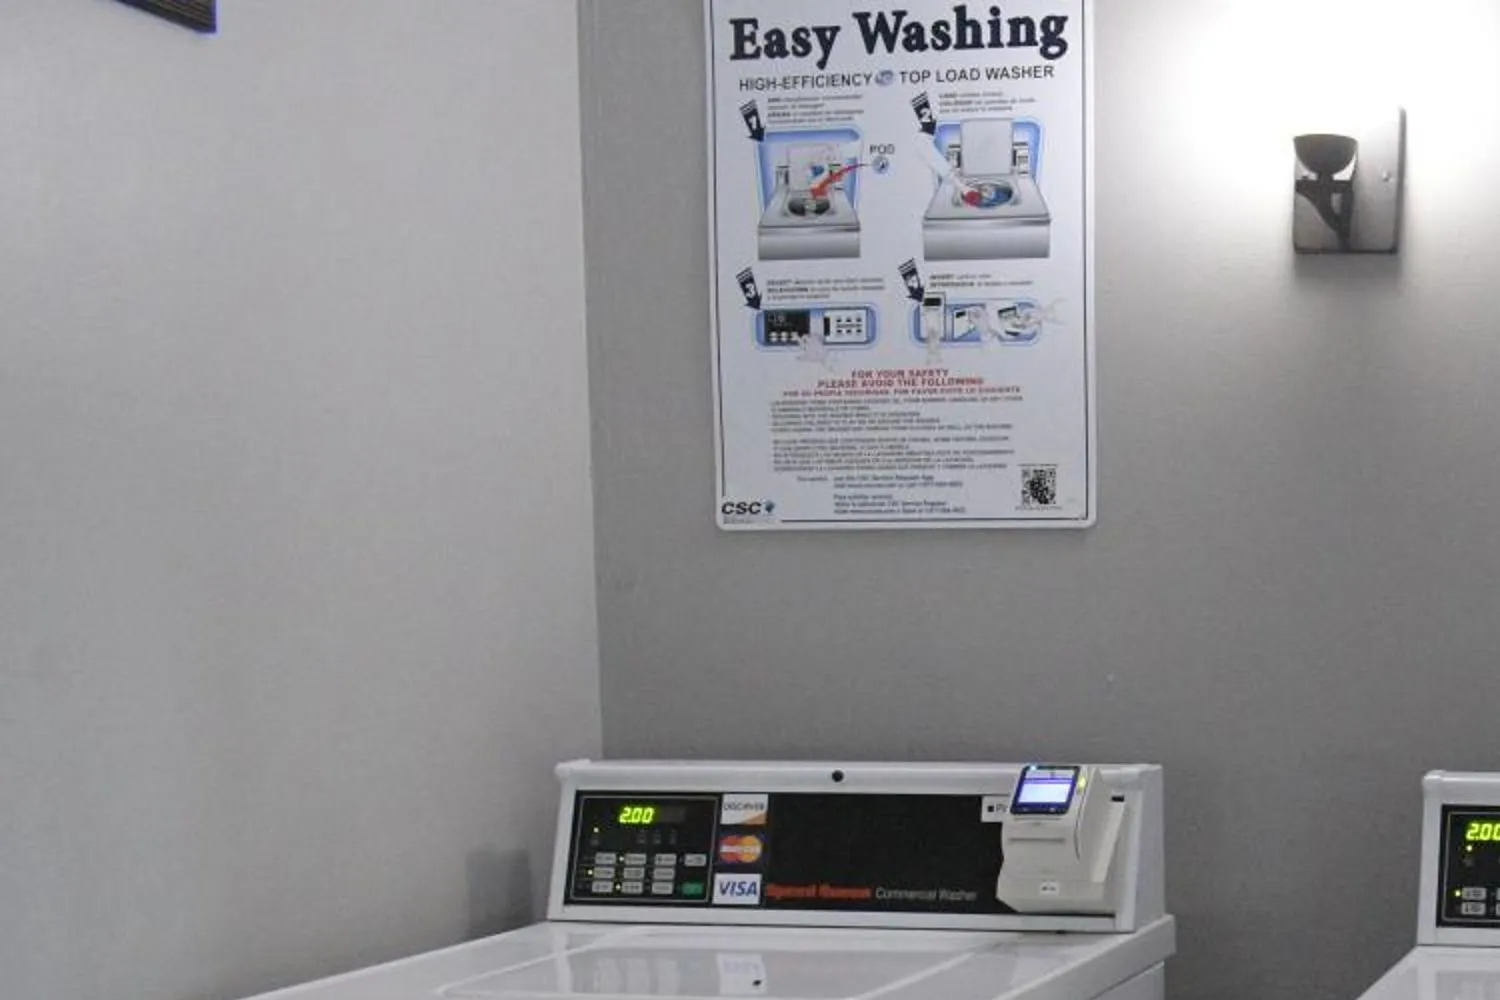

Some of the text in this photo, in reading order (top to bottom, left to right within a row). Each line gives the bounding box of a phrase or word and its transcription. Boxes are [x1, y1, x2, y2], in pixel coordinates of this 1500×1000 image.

[729, 5, 1069, 70] Easy Washing
[739, 65, 1055, 92] HIGH-EFFICIENCY TOP LOAD WASHER
[920, 107, 932, 123] 2
[869, 143, 895, 155] POD
[852, 368, 949, 379] FOR YOUR SAFETY
[817, 377, 984, 389] PLEASE AVOID THE FOLLOWING
[721, 501, 762, 516] CSC
[619, 806, 656, 825] 2.00
[719, 880, 758, 897] VISA
